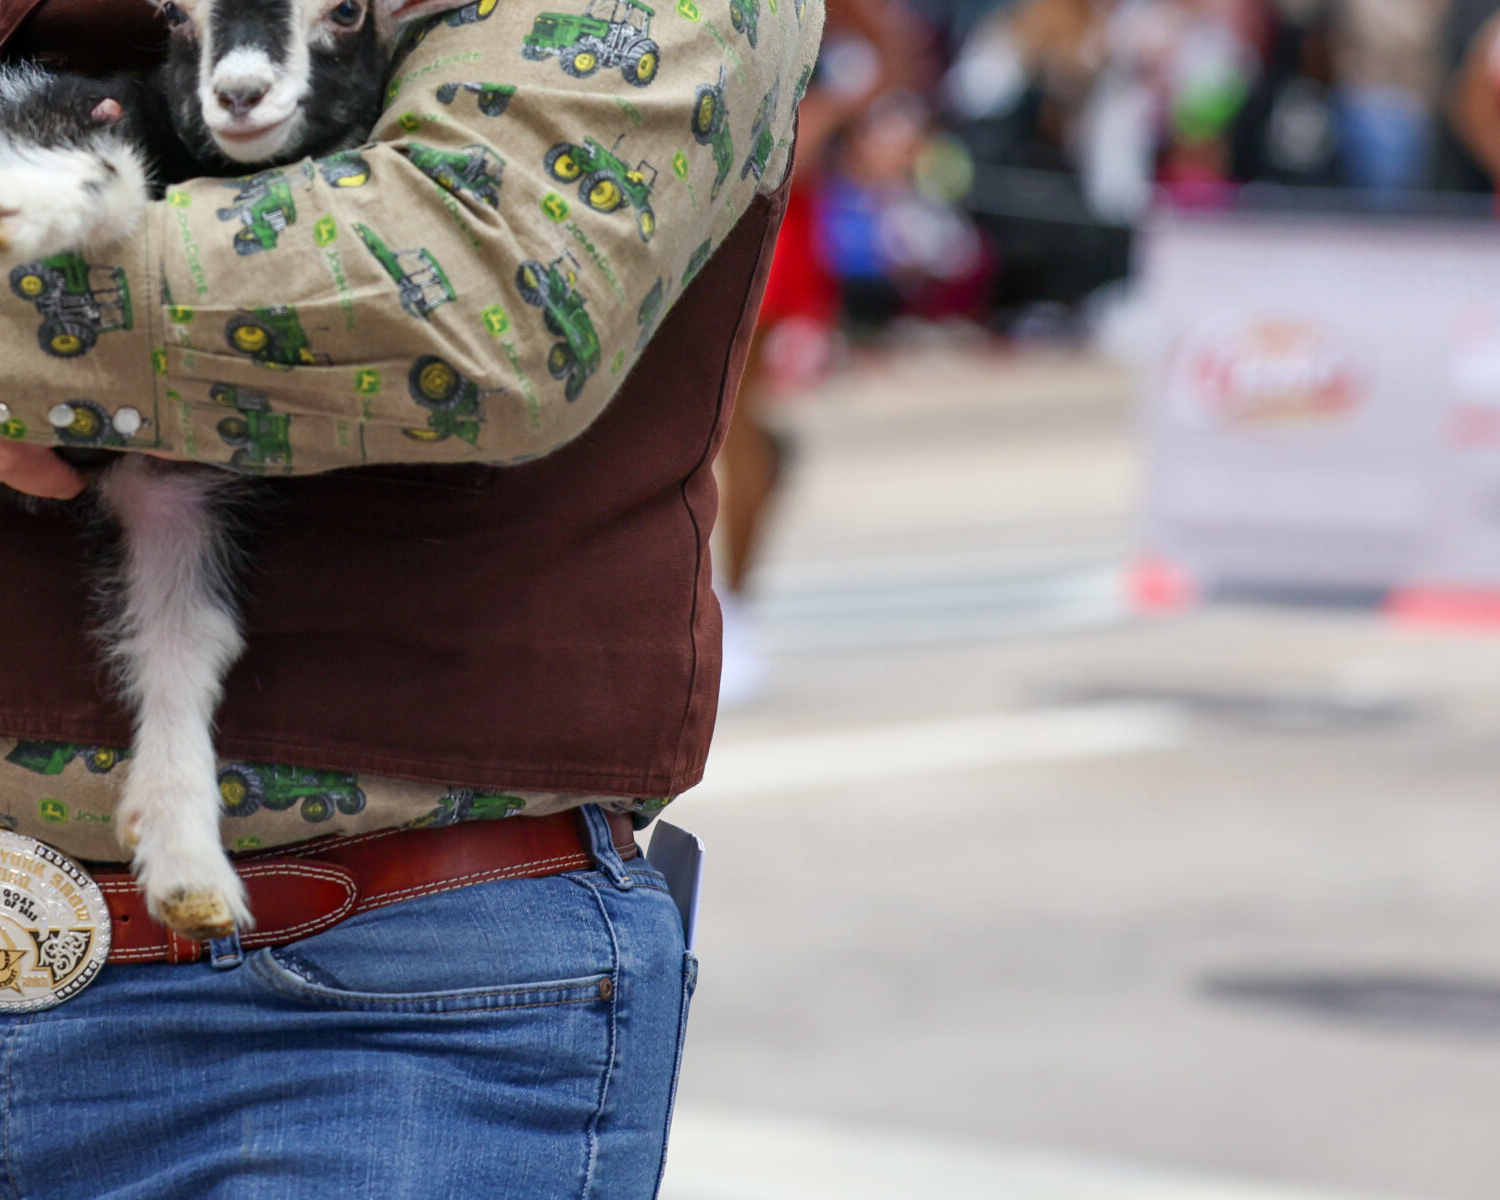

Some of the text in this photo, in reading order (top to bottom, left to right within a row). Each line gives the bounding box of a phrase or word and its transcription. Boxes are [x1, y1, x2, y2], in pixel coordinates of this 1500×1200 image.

[3, 888, 35, 909] GOAT
[4, 898, 17, 909] OF
[49, 873, 92, 921] SHOW
